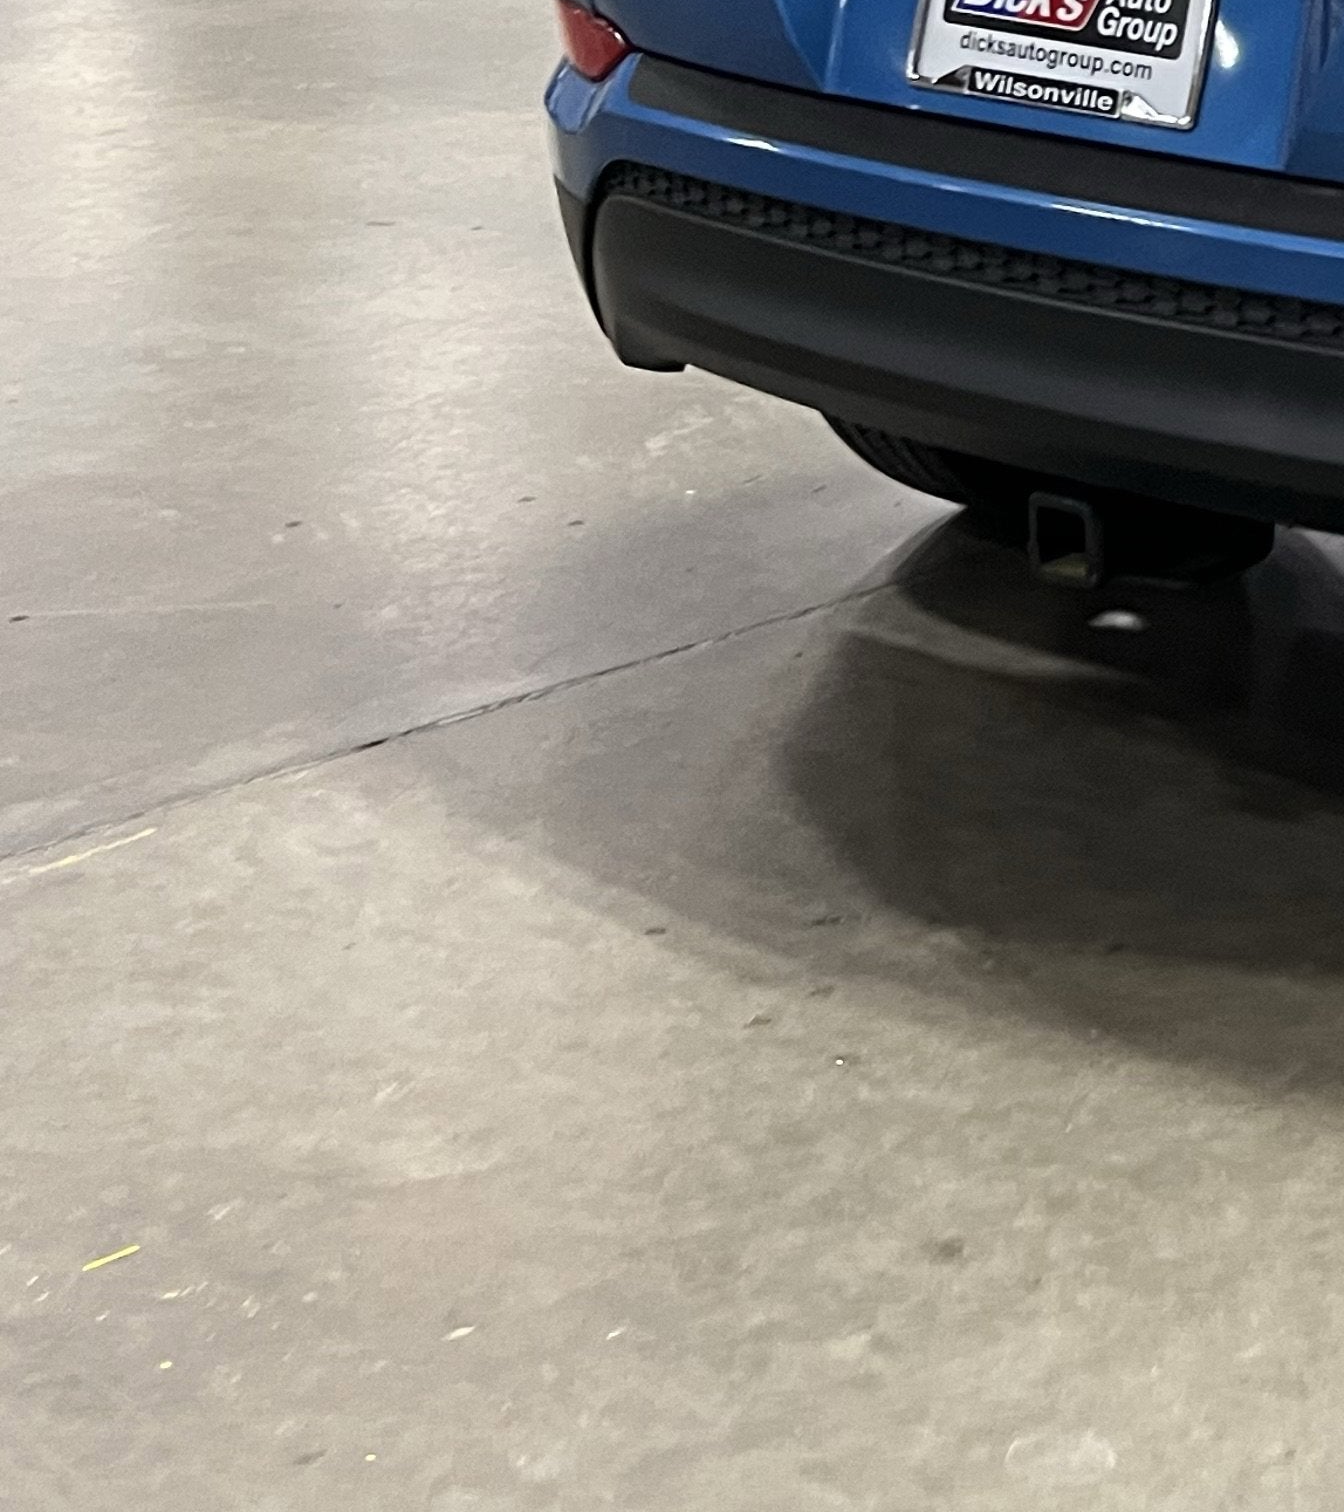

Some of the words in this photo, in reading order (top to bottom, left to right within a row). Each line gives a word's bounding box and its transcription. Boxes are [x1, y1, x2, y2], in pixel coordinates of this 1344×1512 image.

[1096, 6, 1179, 52] Group
[959, 30, 1153, 81] dicksautogroup.com
[974, 71, 1115, 112] Wilsonville
